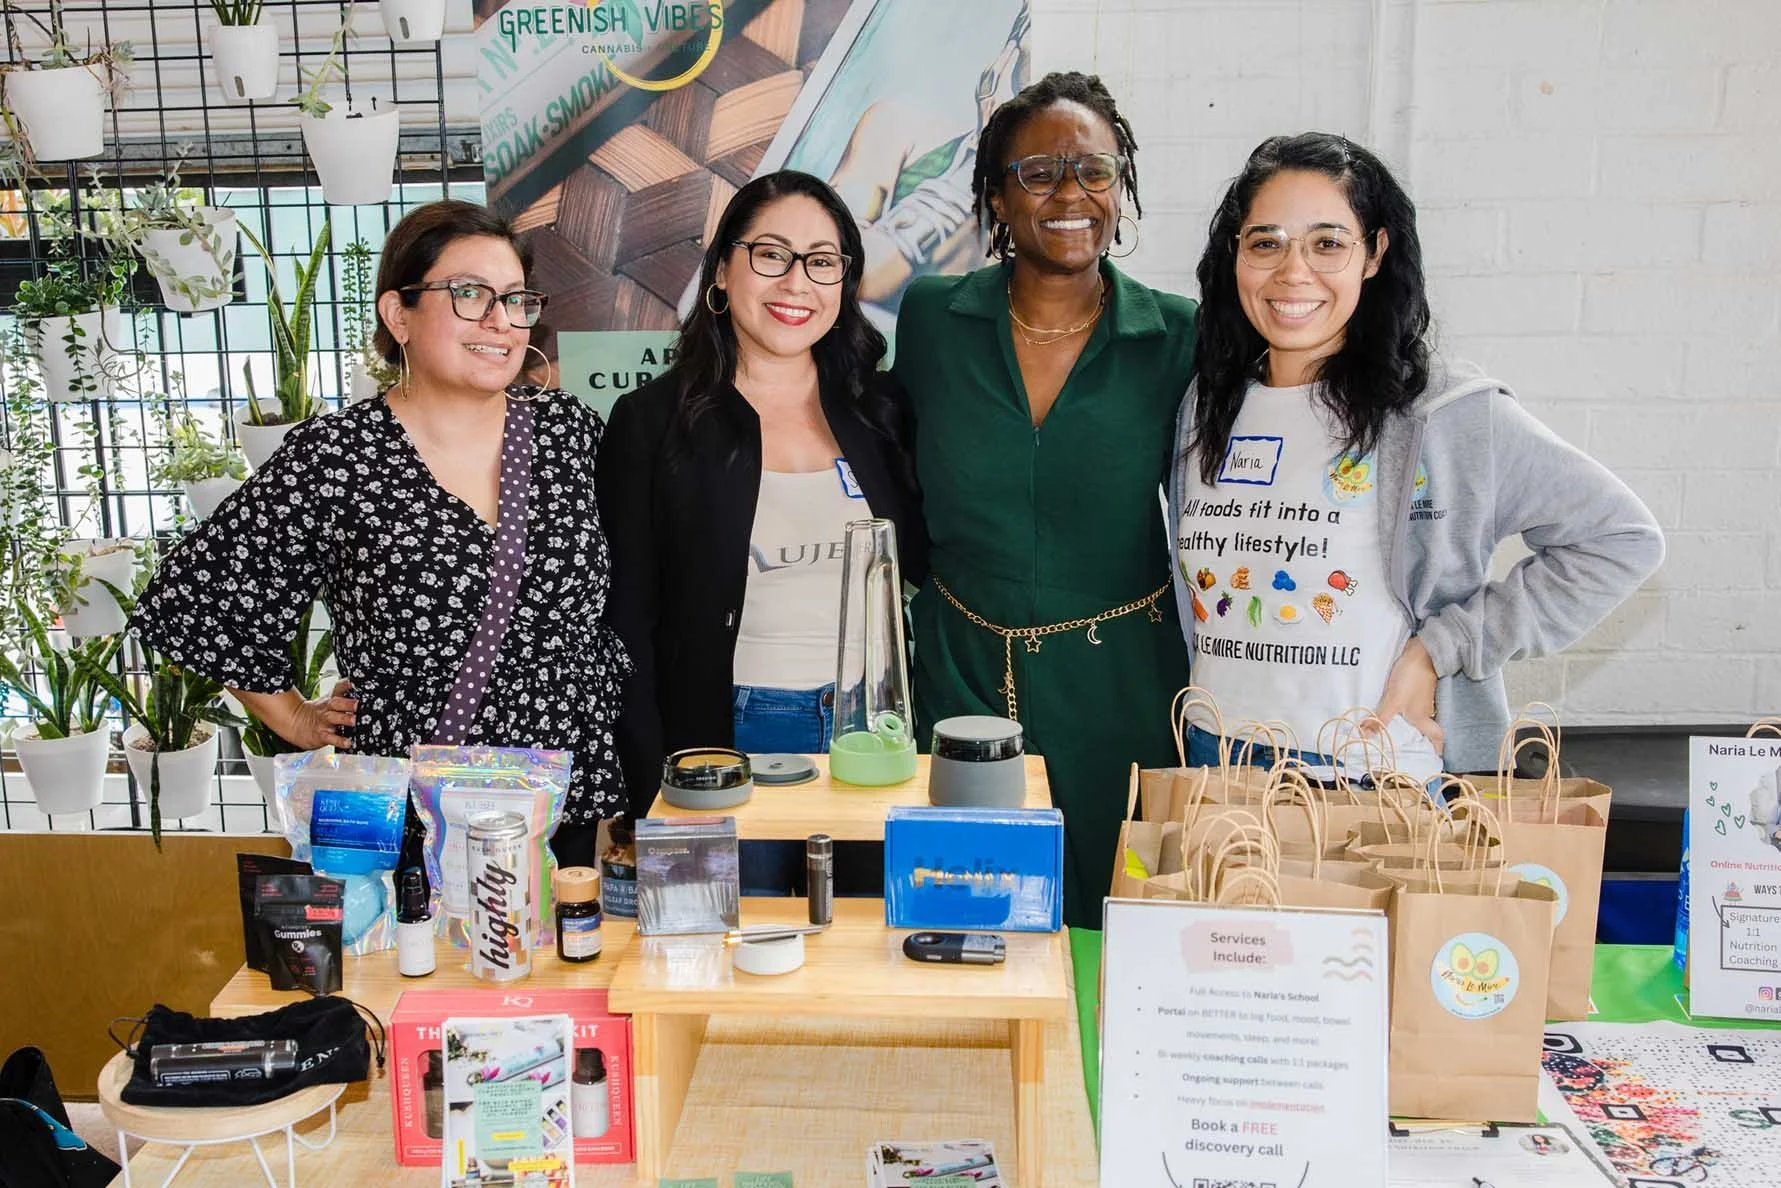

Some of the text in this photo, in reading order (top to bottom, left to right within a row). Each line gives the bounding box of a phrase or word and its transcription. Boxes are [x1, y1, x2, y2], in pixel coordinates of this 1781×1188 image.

[500, 2, 723, 52] GREENISH VIBES
[581, 44, 642, 54] CANNABIS
[1230, 450, 1263, 470] Naria
[1183, 498, 1341, 524] All foods fit into a
[1234, 531, 1328, 562] lifestyle!
[1245, 641, 1327, 665] NUTRITION
[1331, 646, 1361, 666] LLC
[1708, 743, 1746, 757] Naria
[1749, 745, 1766, 757] Le
[1710, 860, 1743, 871] Online
[1754, 884, 1777, 896] WAYS
[476, 860, 519, 969] highly
[1729, 911, 1781, 925] Signature
[274, 928, 322, 940] Gummies
[1210, 931, 1267, 946] Services
[1746, 927, 1761, 937] 1:1
[1729, 941, 1777, 952] Nutrition
[1213, 950, 1269, 964] Include:
[1728, 955, 1778, 969] Coaching
[1254, 990, 1285, 1001] Naria's
[1287, 992, 1320, 1002] School
[1158, 1006, 1186, 1017] Portal
[1201, 1008, 1237, 1020] BETTER
[1203, 1052, 1245, 1065] coaching
[1246, 1054, 1268, 1065] calls
[1306, 1058, 1349, 1072] packages
[1182, 1072, 1220, 1086] Ongoing
[1222, 1076, 1259, 1089] support
[1191, 1118, 1279, 1136] Book a FREE
[1185, 1138, 1285, 1159] discovery call
